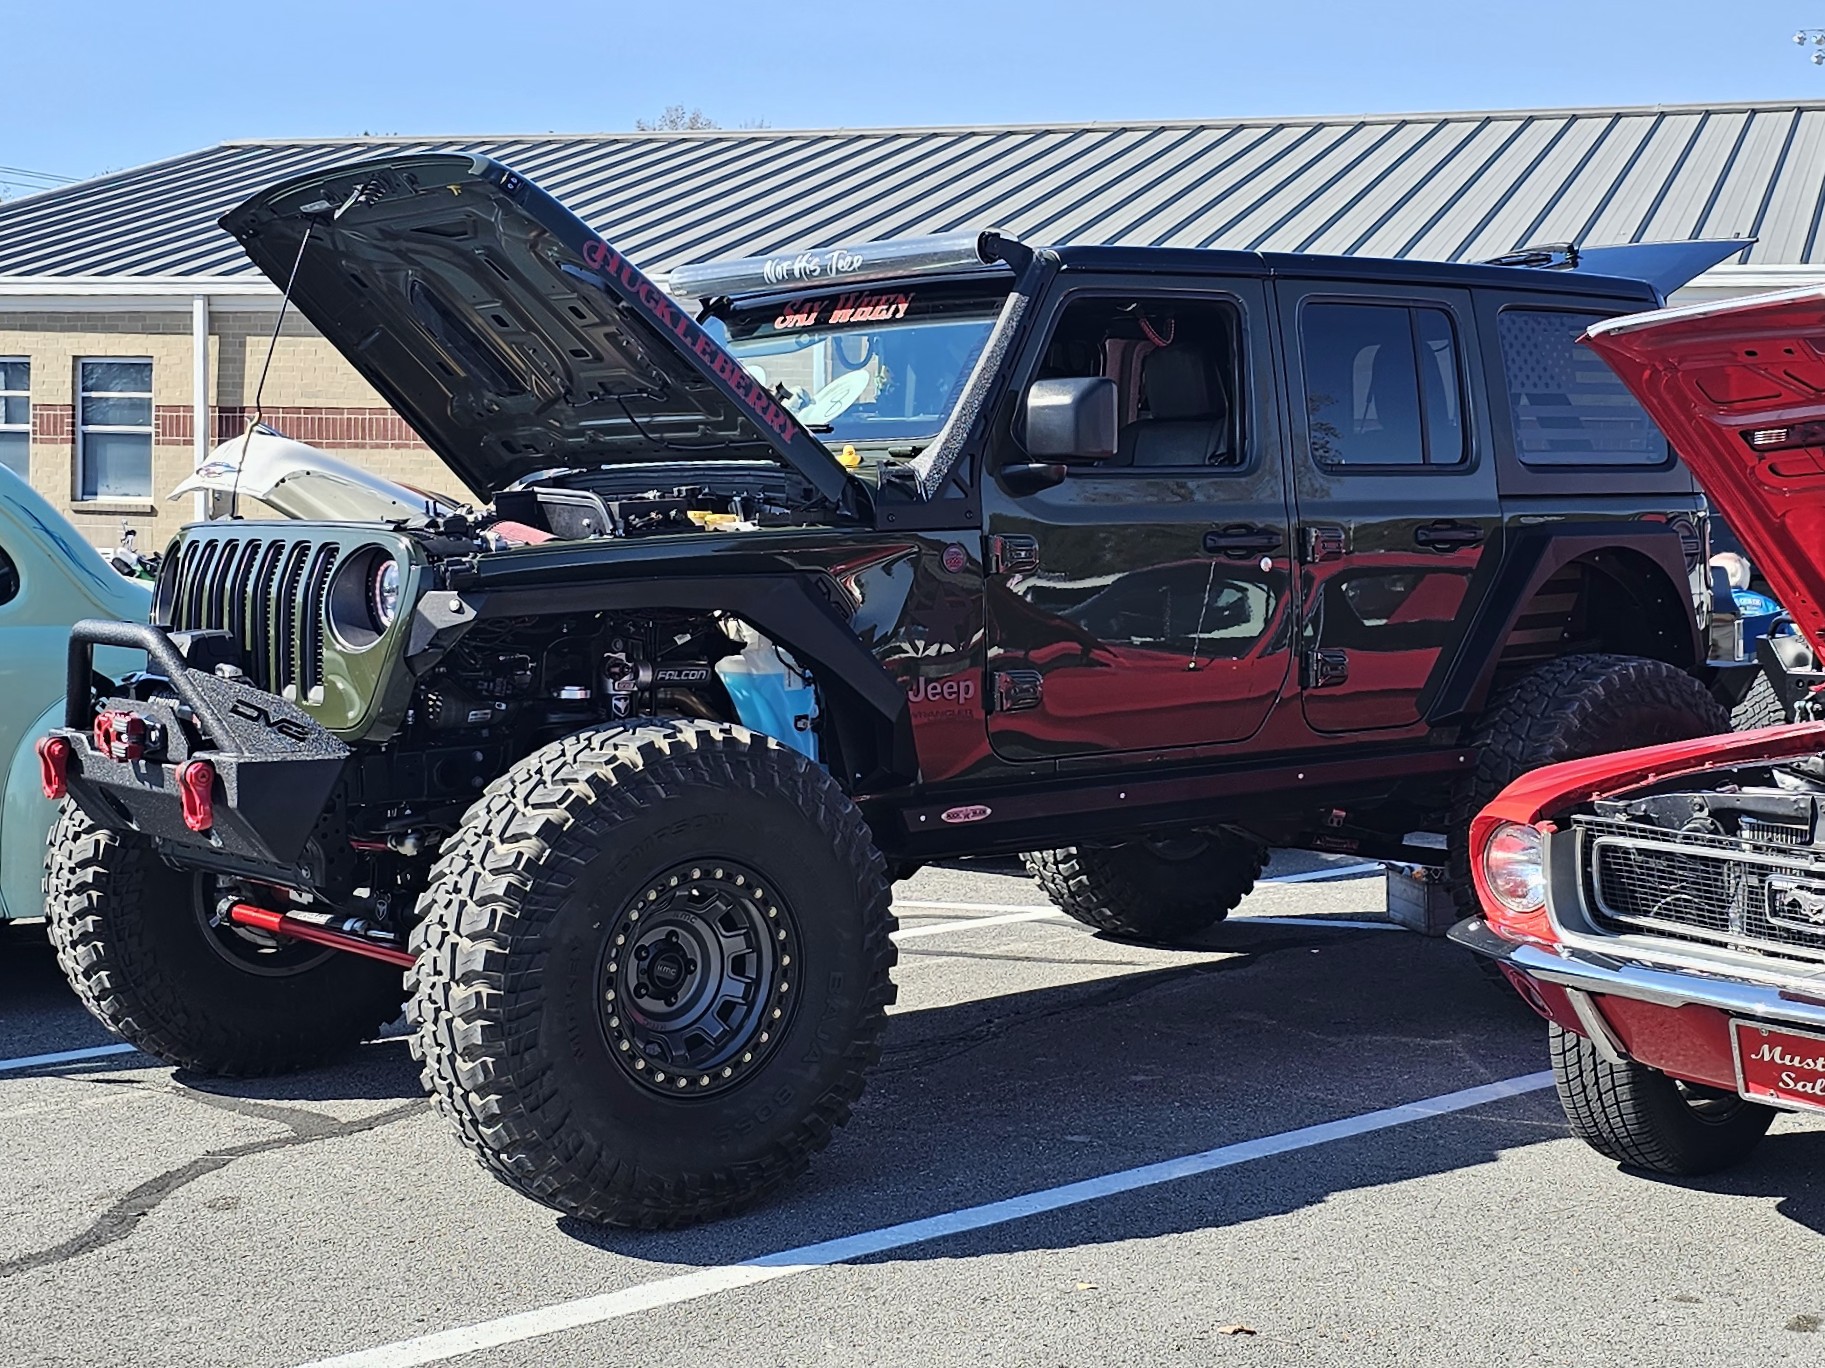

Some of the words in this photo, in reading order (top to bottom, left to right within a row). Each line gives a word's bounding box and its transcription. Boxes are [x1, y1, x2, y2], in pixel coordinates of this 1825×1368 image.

[582, 240, 800, 445] HUCKLEBERRY
[656, 668, 707, 681] FALCON
[907, 676, 975, 704] Jeep
